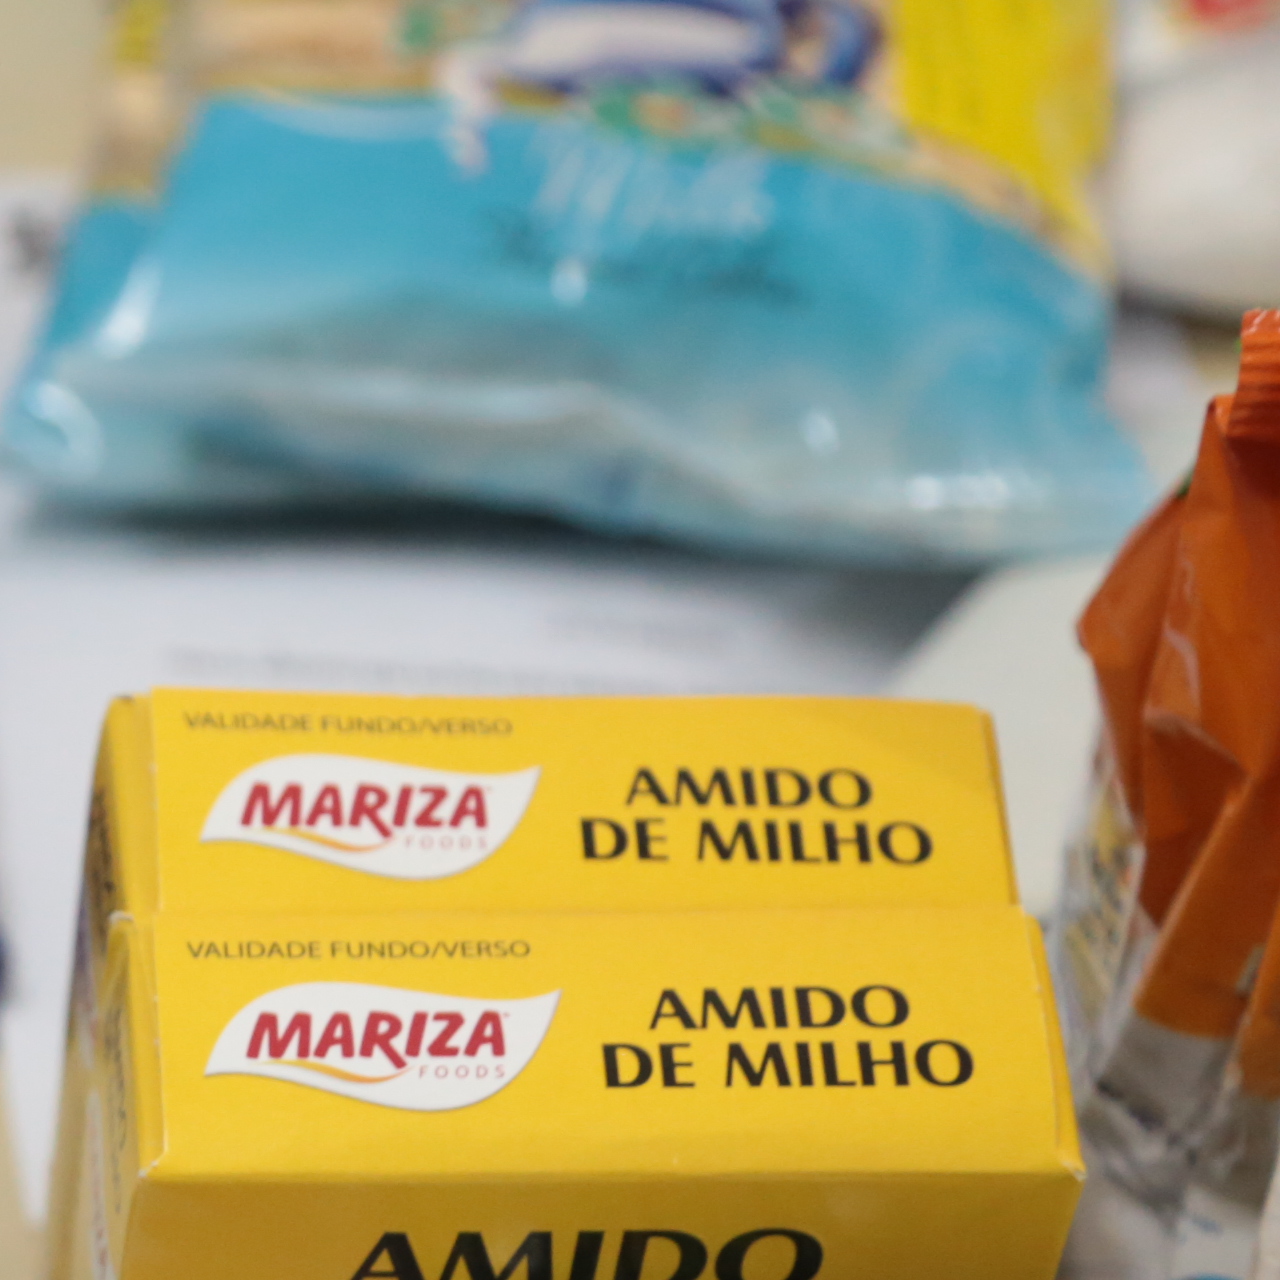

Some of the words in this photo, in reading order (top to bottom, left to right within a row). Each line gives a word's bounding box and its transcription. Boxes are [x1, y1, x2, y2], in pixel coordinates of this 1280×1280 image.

[184, 711, 313, 734] VALIDADE
[320, 713, 513, 737] FUNDO/VERSO
[239, 780, 490, 842] MARIZA
[624, 766, 875, 812] AMIDO
[403, 835, 489, 851] FOODS
[579, 817, 669, 862] DE
[696, 818, 936, 867] MILHO
[186, 940, 323, 960] VALIDADE
[329, 939, 531, 961] FUNDO/VERSO
[648, 983, 911, 1032] AMIDO
[245, 1009, 507, 1072] MARIZA
[417, 1065, 507, 1080] FOODS
[601, 1042, 696, 1090] DE
[724, 1039, 975, 1089] MILHO
